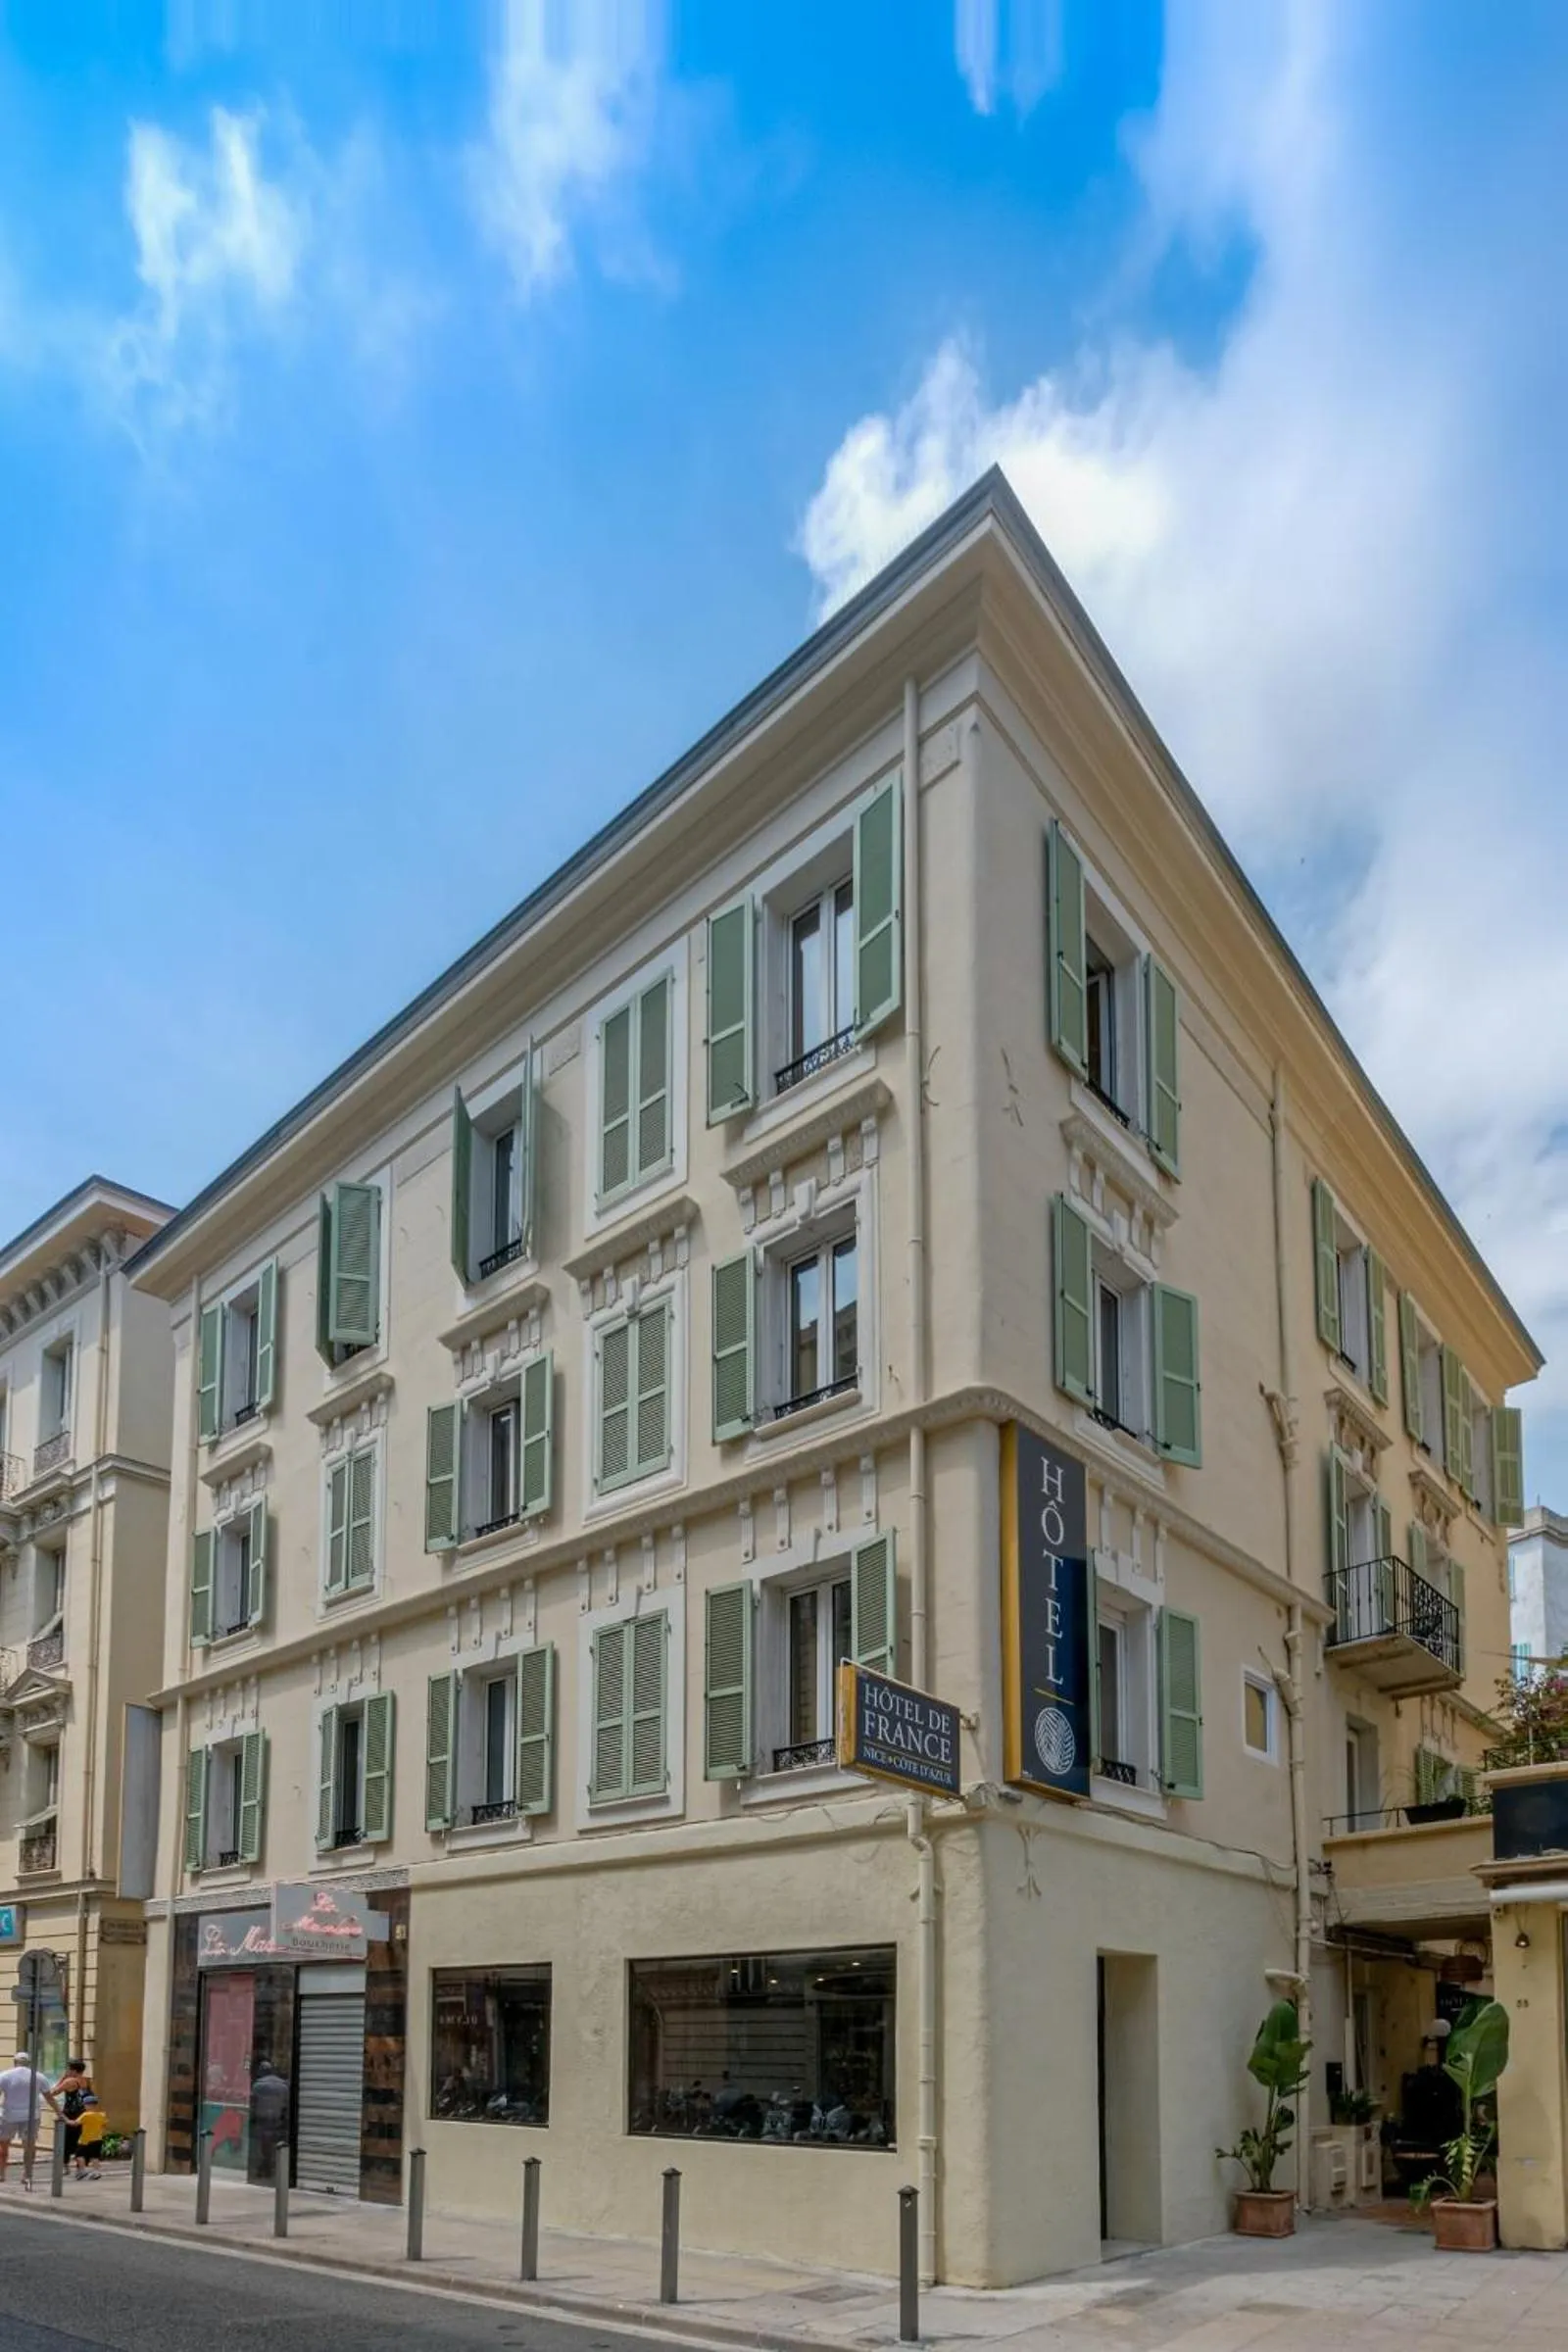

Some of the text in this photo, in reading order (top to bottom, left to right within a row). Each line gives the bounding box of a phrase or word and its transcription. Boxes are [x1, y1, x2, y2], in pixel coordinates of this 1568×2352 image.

[1041, 1456, 1064, 1686] HÔTEL
[864, 1683, 951, 1735] HÔTEL DE
[863, 1709, 953, 1764] FRANCE
[292, 1936, 351, 1951] Boucherie
